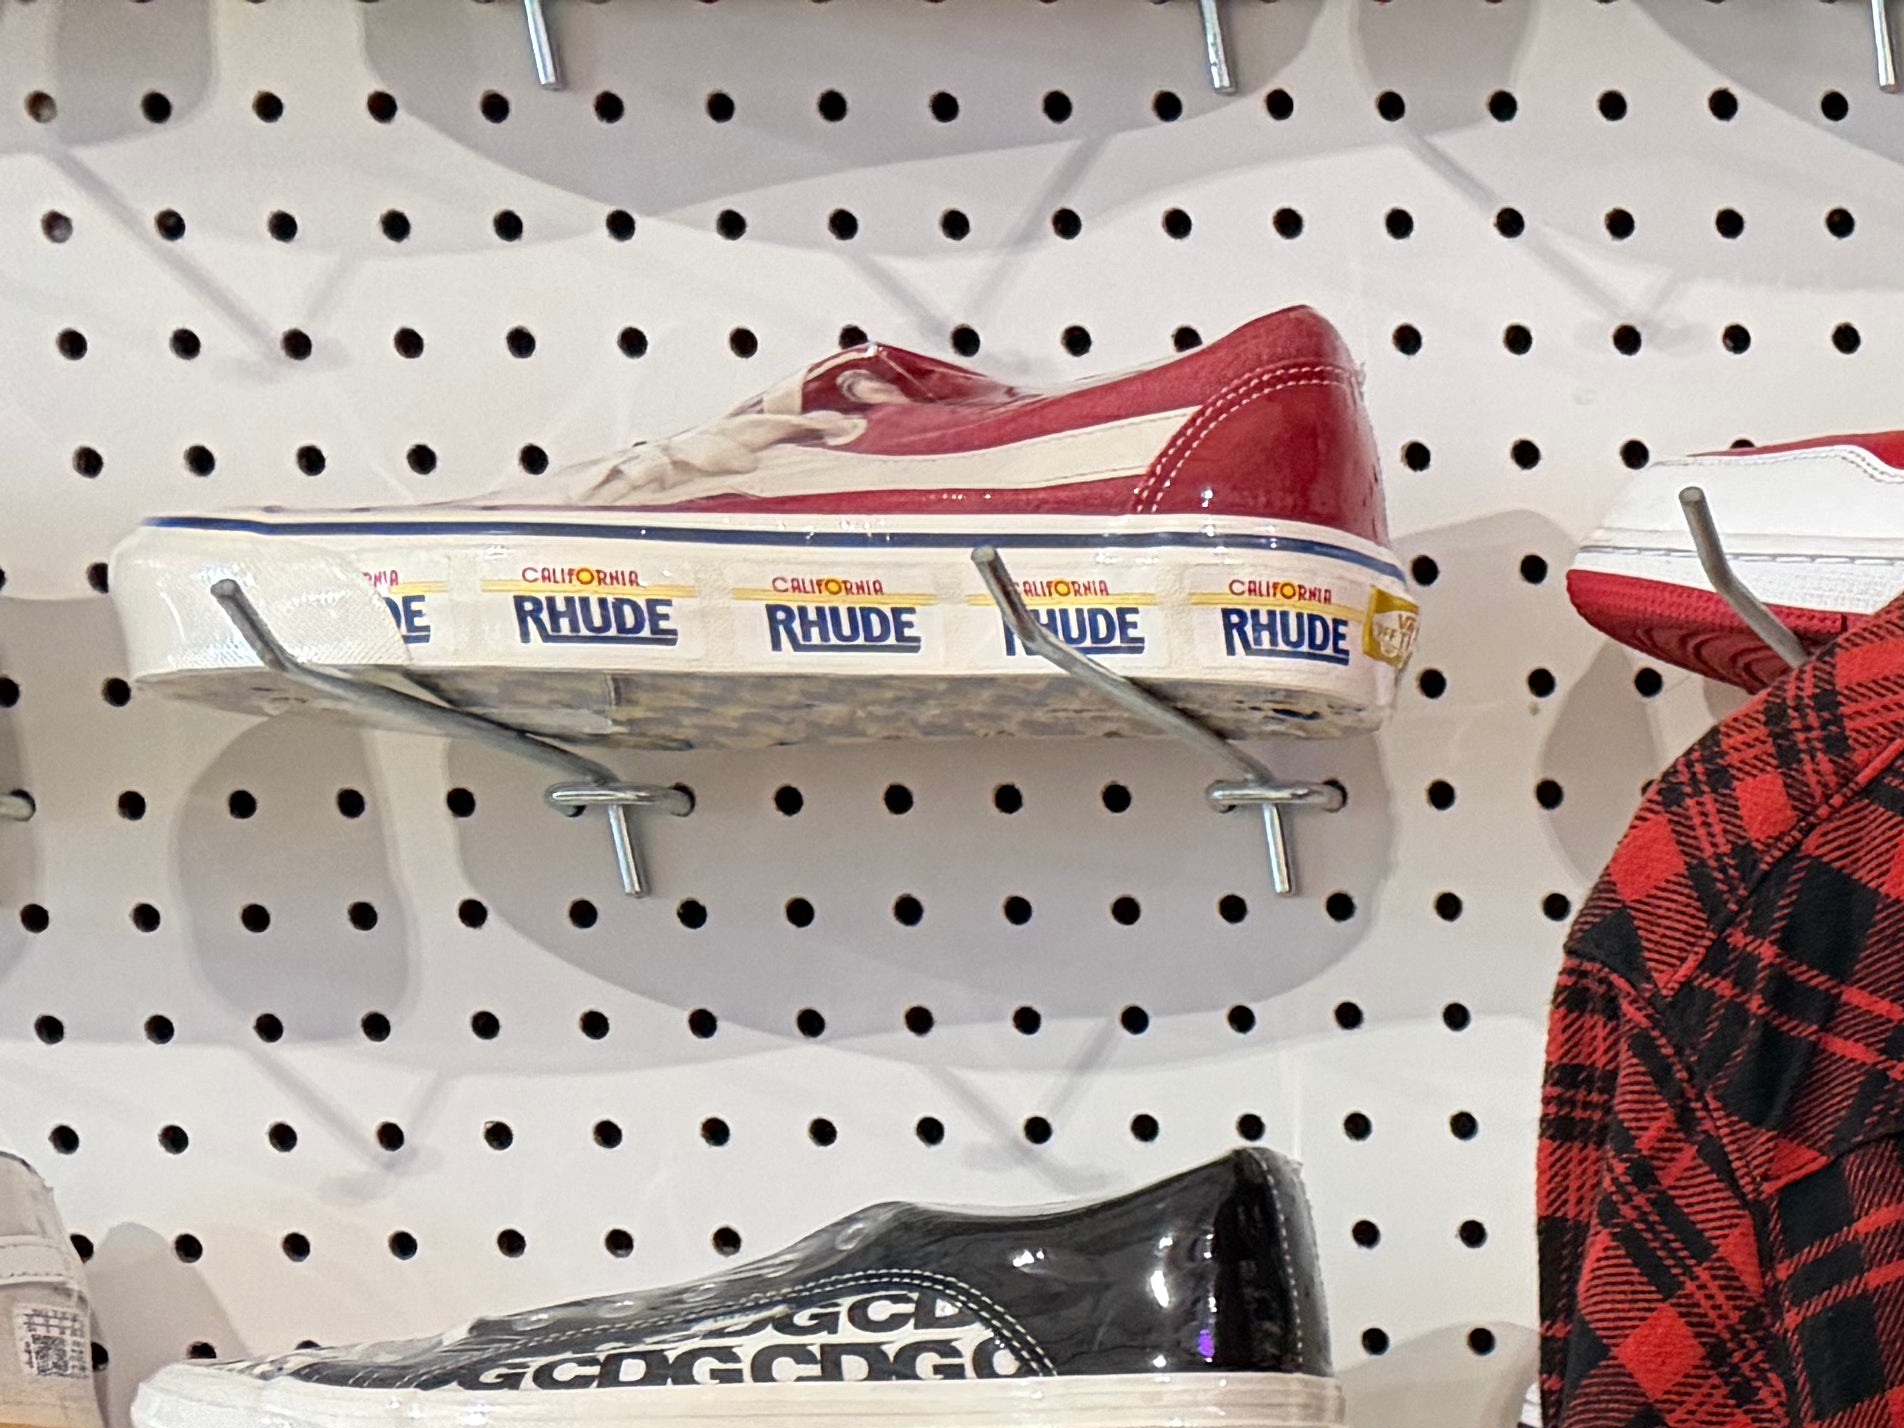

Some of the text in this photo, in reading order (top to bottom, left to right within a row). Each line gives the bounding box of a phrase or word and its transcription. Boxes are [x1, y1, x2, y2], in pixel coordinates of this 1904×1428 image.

[521, 566, 640, 587] CALIFORNIA
[771, 576, 884, 596] CALIFORNIA
[1014, 580, 1110, 597] ALIFORNIA
[1228, 579, 1332, 604] CALIFORNIA
[513, 595, 679, 646] RHUDE
[765, 603, 921, 654] RHUDE
[1221, 607, 1350, 665] RHUDE
